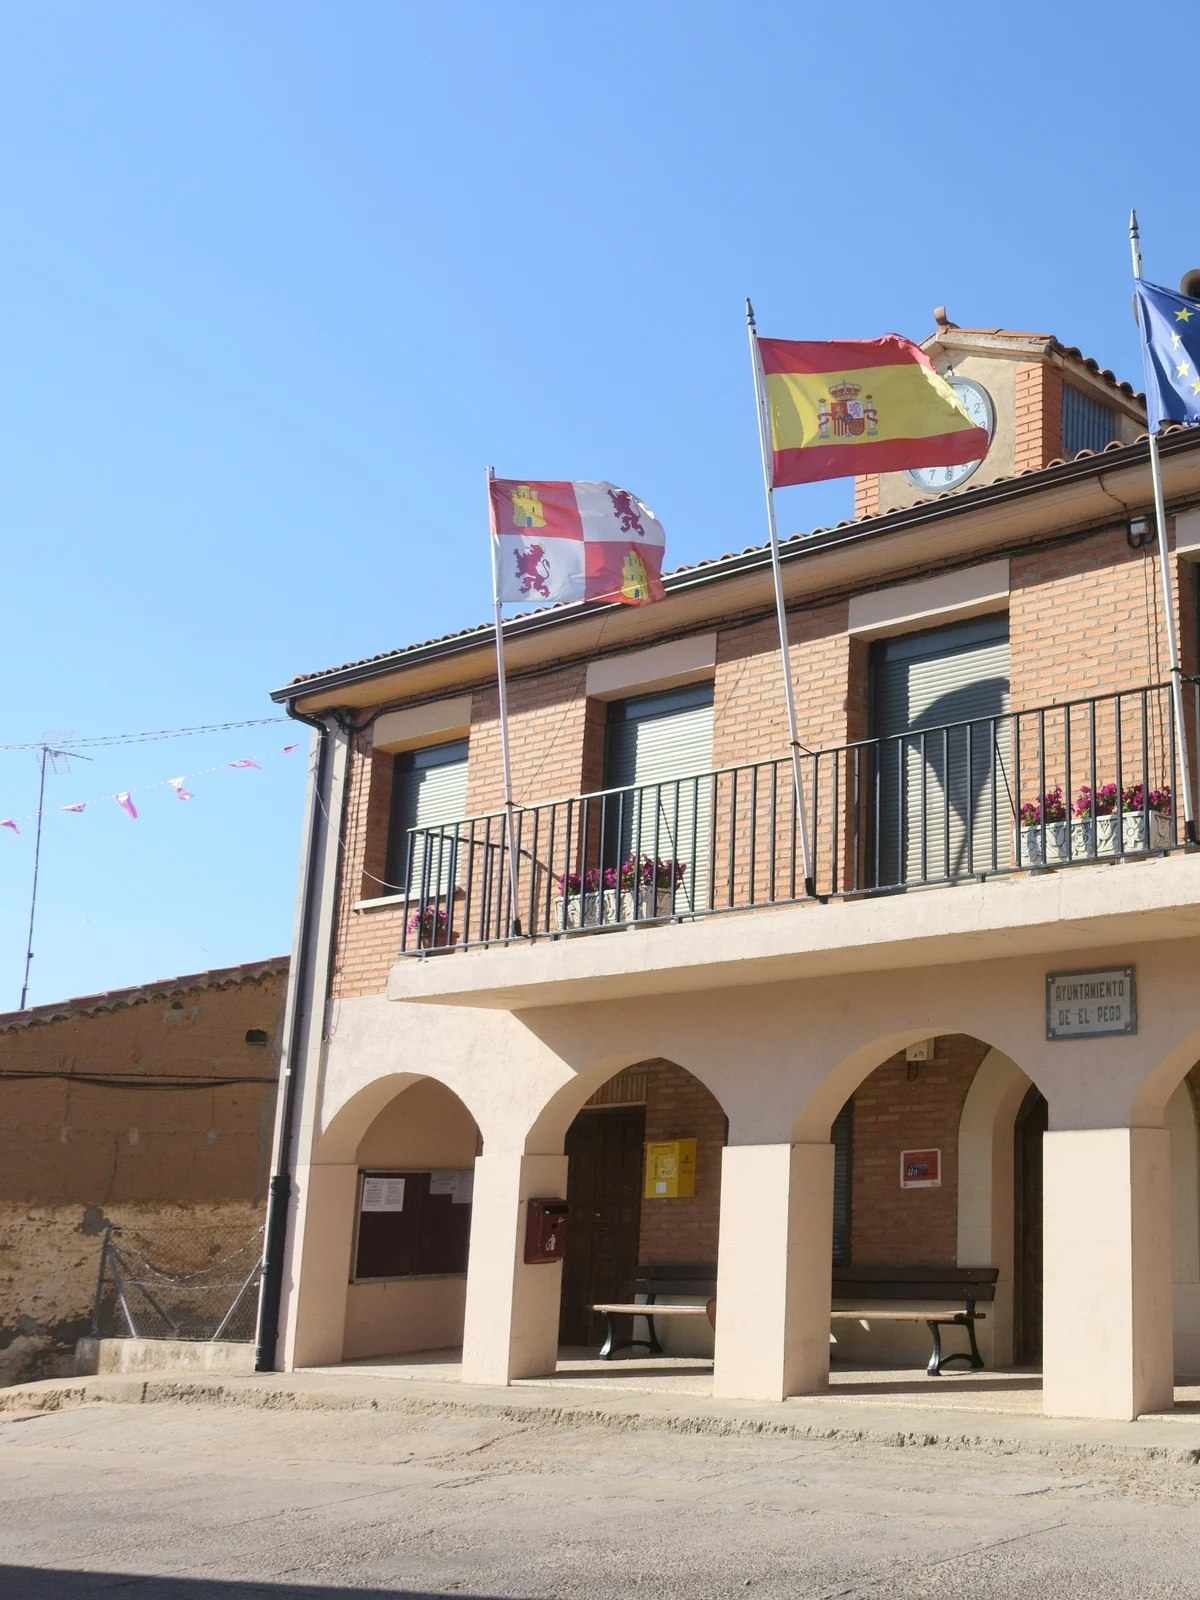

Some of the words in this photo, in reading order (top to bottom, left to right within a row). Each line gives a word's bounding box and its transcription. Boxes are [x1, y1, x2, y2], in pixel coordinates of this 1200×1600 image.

[962, 393, 967, 403] 1
[974, 402, 980, 414] 2
[929, 469, 936, 480] 7
[1056, 980, 1124, 1001] AYUNTAMIENTO
[1059, 1009, 1071, 1026] DE
[1078, 1008, 1090, 1025] EL
[1097, 1005, 1121, 1023] PEGO
